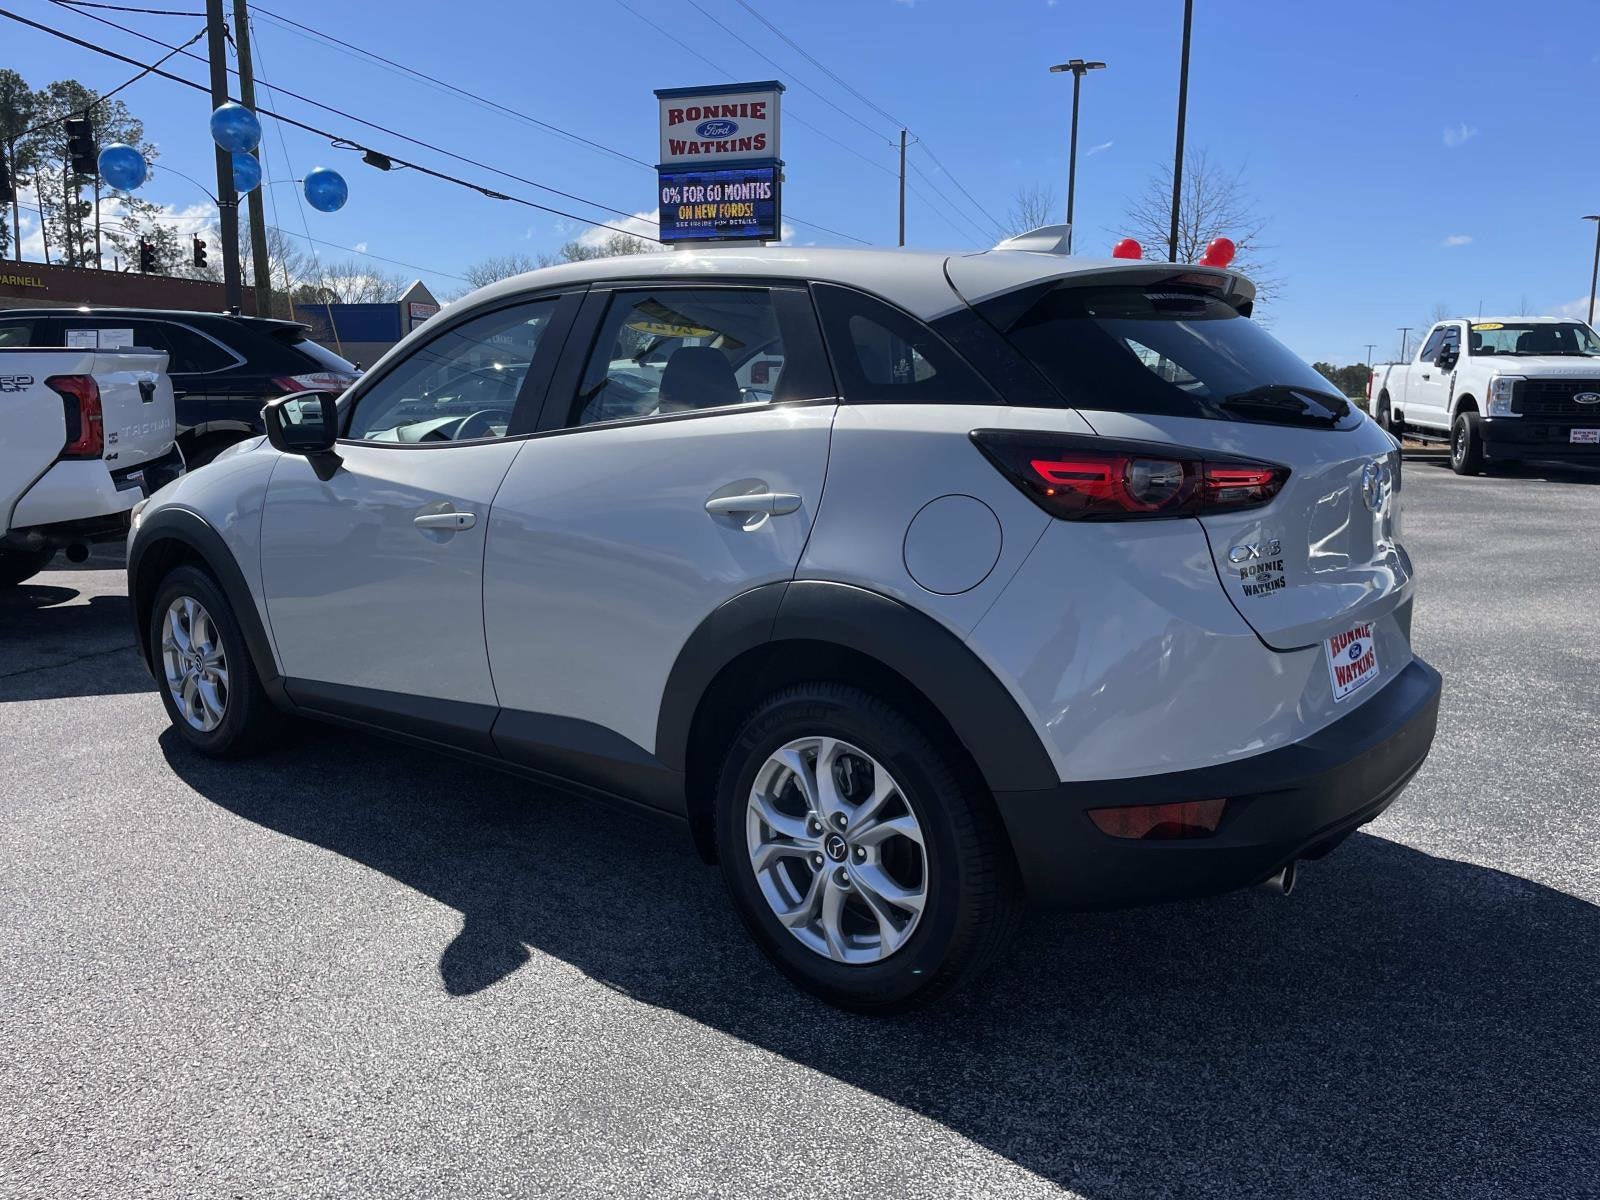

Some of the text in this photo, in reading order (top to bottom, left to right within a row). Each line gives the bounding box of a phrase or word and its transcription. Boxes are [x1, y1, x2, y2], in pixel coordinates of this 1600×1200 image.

[668, 102, 766, 126] RONNIE
[704, 122, 730, 136] Ford
[668, 133, 766, 155] WATKINS
[662, 183, 771, 203] 0% FOR 60 MONTHS
[678, 202, 754, 219] ON NEW FORDS!
[1228, 538, 1281, 563] CX-3
[1240, 560, 1284, 581] RONNIE
[1242, 575, 1286, 597] WATKINS
[1334, 645, 1375, 688] WATKINS
